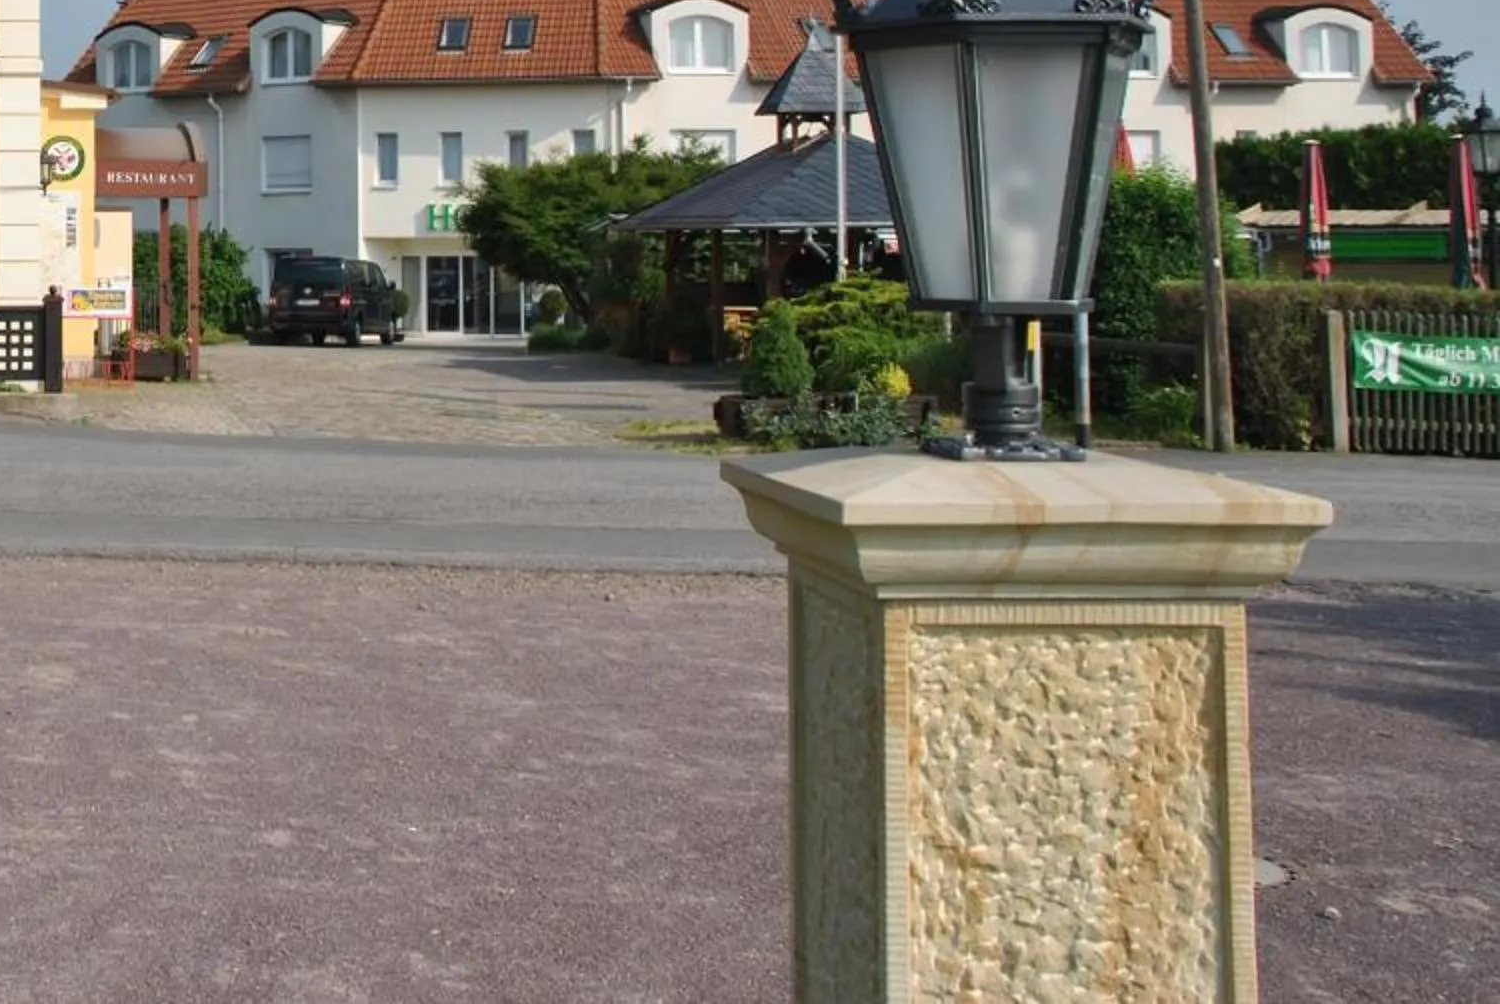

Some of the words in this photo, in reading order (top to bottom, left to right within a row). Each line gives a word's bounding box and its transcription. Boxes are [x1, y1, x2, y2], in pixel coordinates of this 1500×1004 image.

[106, 170, 197, 185] RESTAURANT
[1411, 341, 1477, 362] Täglich
[1437, 371, 1462, 387] ab
